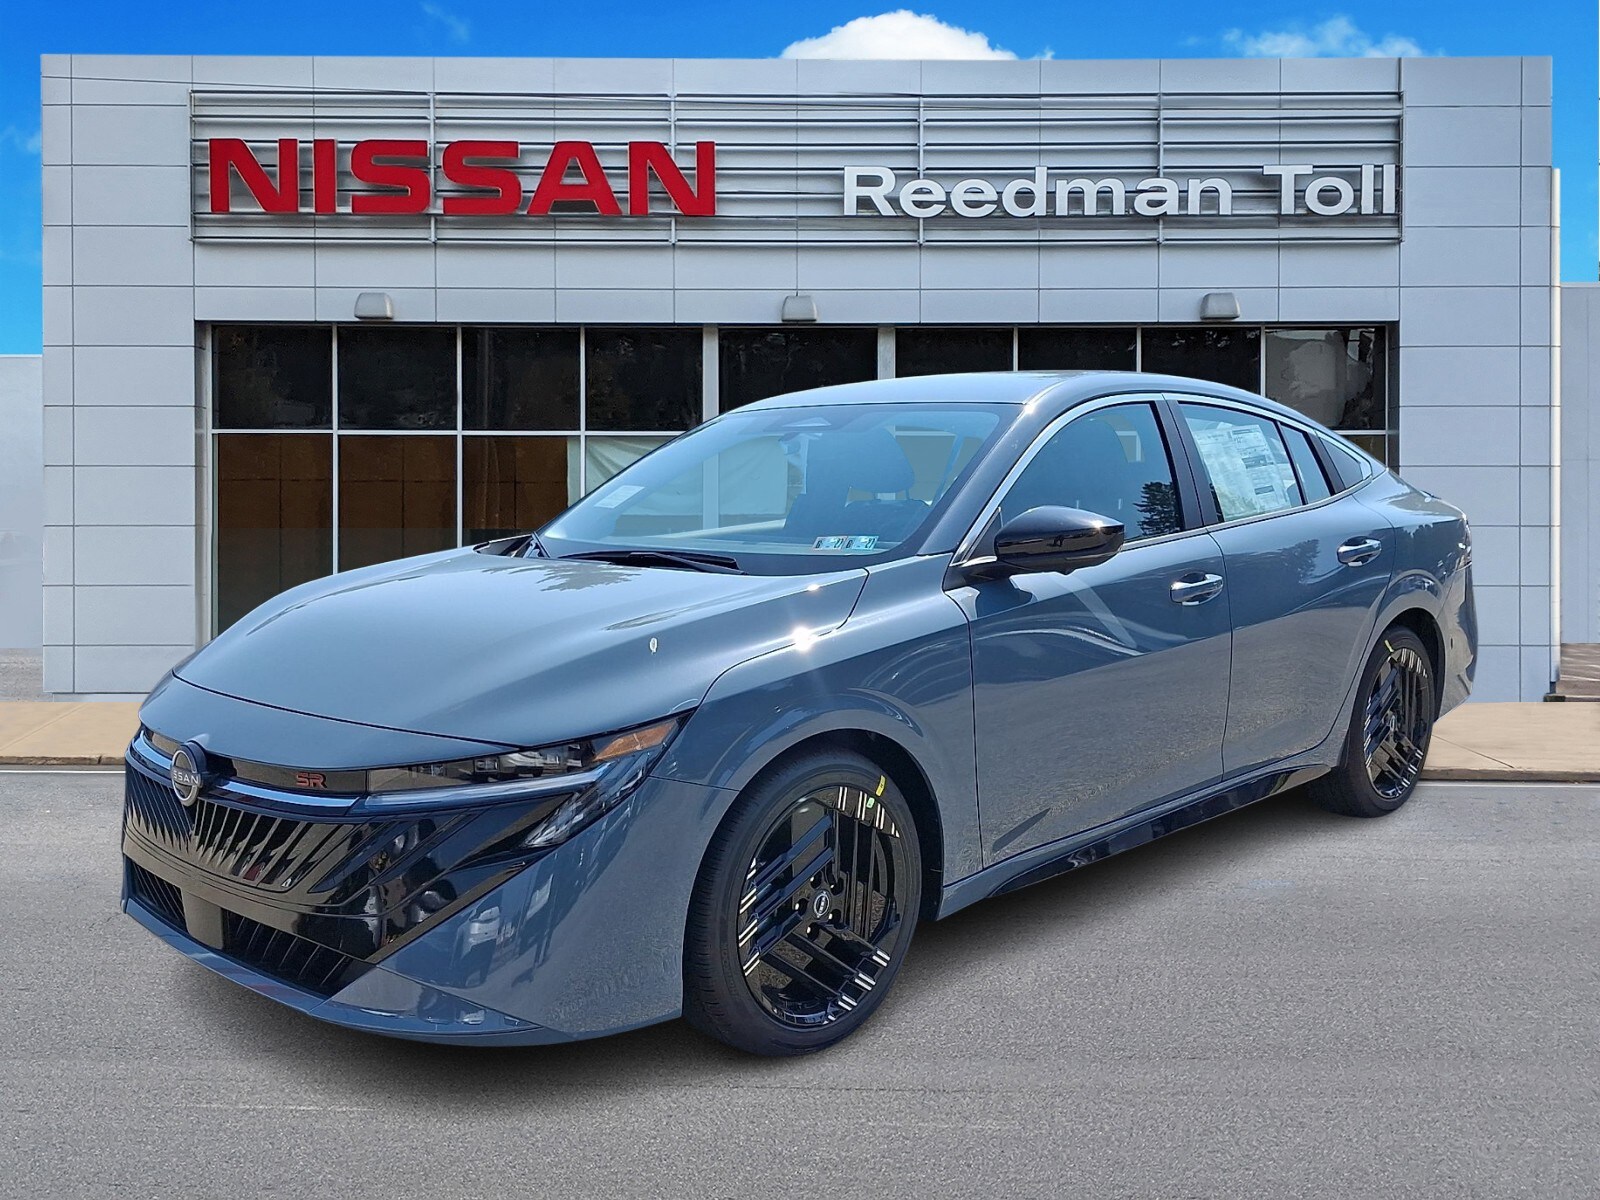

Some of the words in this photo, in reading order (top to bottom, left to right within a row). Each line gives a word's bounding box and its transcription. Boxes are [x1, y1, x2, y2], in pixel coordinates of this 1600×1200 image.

[209, 138, 716, 216] NISSAN
[842, 166, 1233, 219] Reedman
[1262, 164, 1397, 216] Toll
[295, 772, 327, 788] SR
